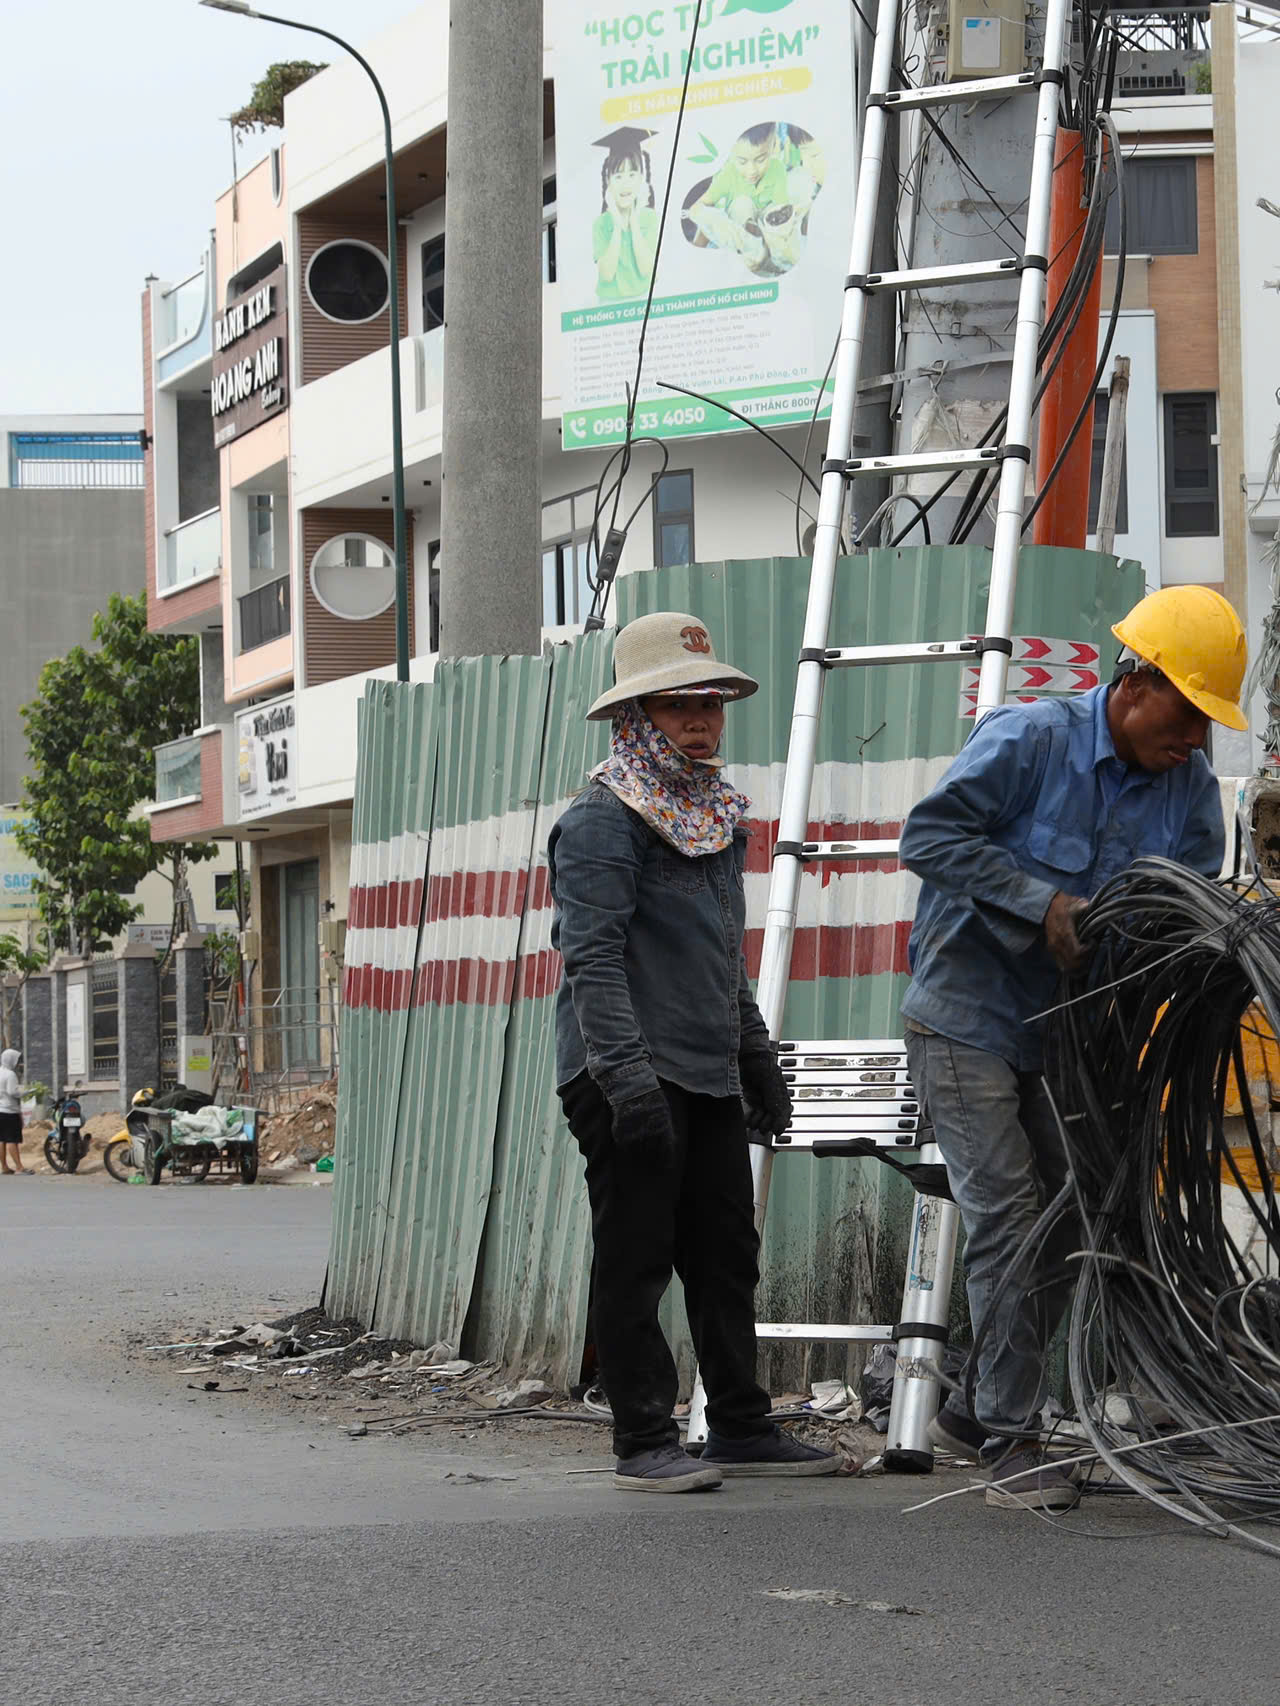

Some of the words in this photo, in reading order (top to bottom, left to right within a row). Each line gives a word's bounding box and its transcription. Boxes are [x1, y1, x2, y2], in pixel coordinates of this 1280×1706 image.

[601, 44, 670, 88] TRẢI
[750, 289, 773, 300] MINH
[640, 411, 658, 430] 33
[663, 407, 705, 427] 4050
